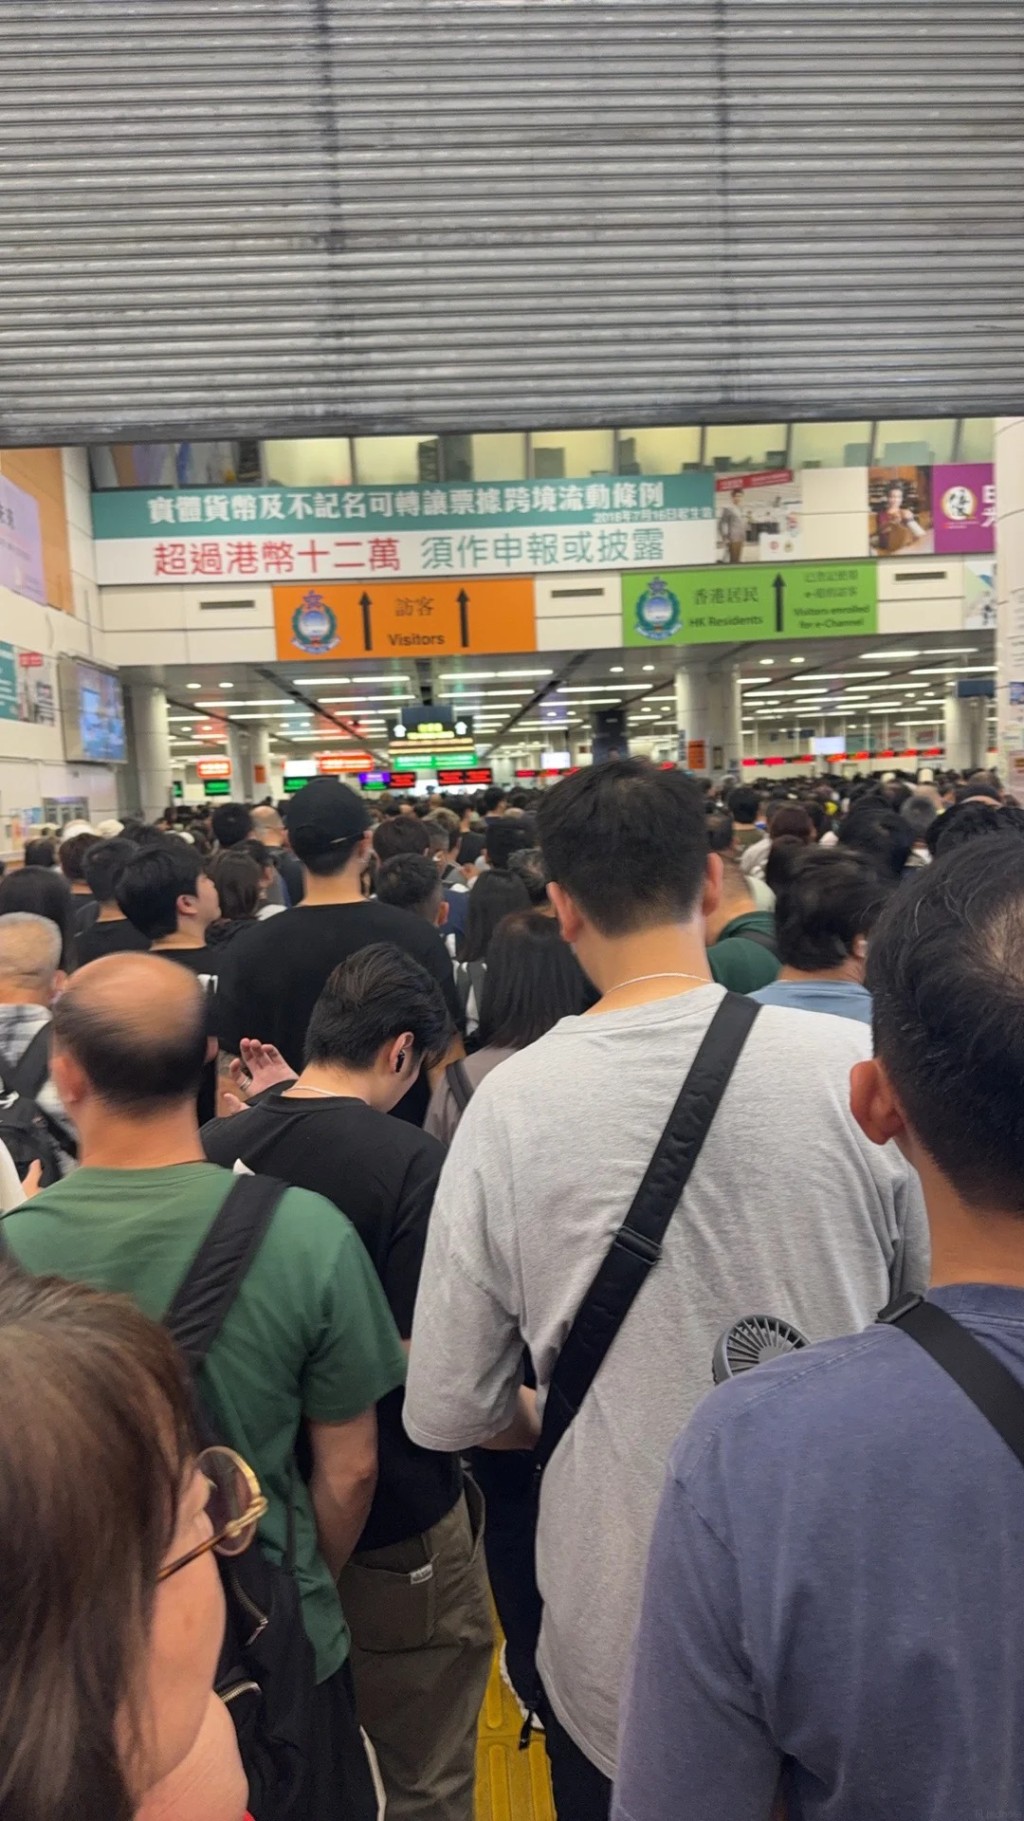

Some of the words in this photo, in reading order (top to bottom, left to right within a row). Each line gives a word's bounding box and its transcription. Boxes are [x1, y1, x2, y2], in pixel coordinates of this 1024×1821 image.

[154, 537, 401, 577] 超過港幣十二萬
[420, 527, 665, 570] 須作申報或披露
[694, 586, 759, 606] 香港居民
[395, 596, 434, 617] 訪客
[830, 605, 870, 615] enrolled
[689, 617, 705, 628] HK
[708, 616, 764, 627] Residents
[388, 633, 446, 647] Visitors
